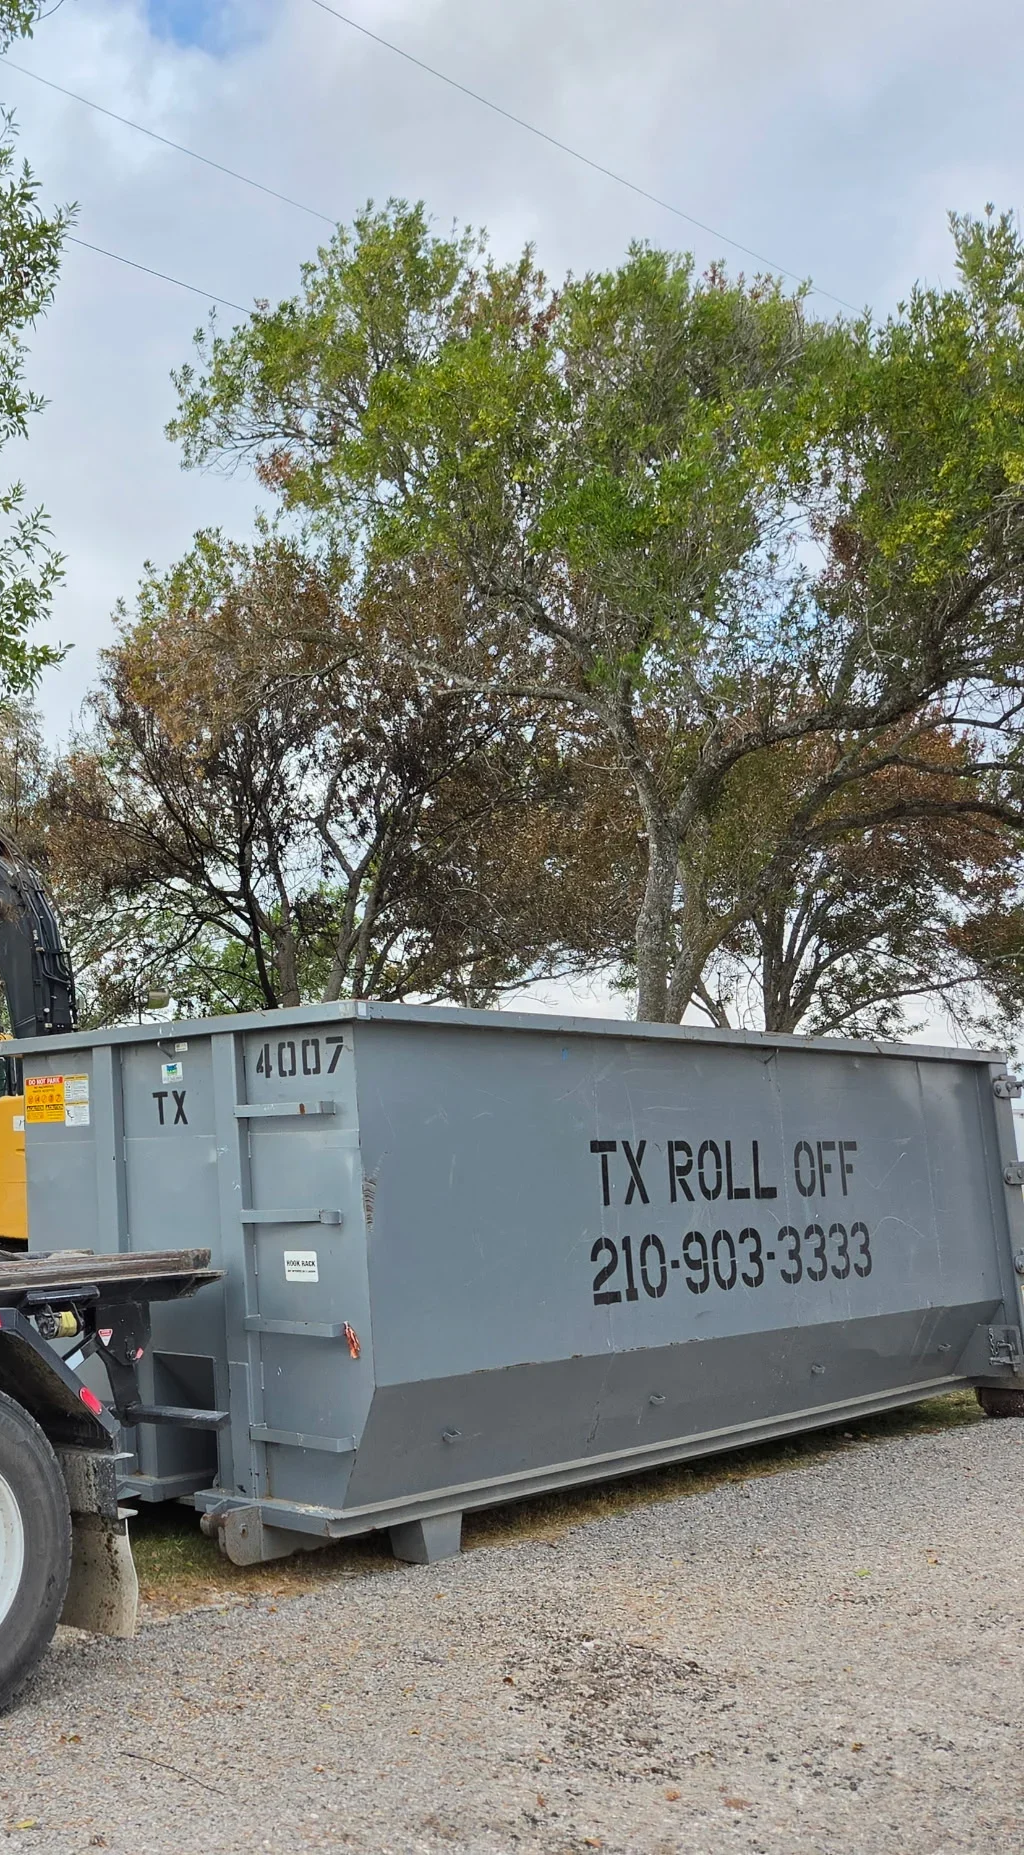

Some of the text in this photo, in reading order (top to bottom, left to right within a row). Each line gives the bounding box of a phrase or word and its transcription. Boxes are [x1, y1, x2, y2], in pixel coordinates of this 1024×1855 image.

[256, 1036, 343, 1078] 4007
[152, 1090, 188, 1125] TX
[590, 1140, 857, 1206] TX ROLL OFF
[591, 1222, 872, 1305] 210-903-3333
